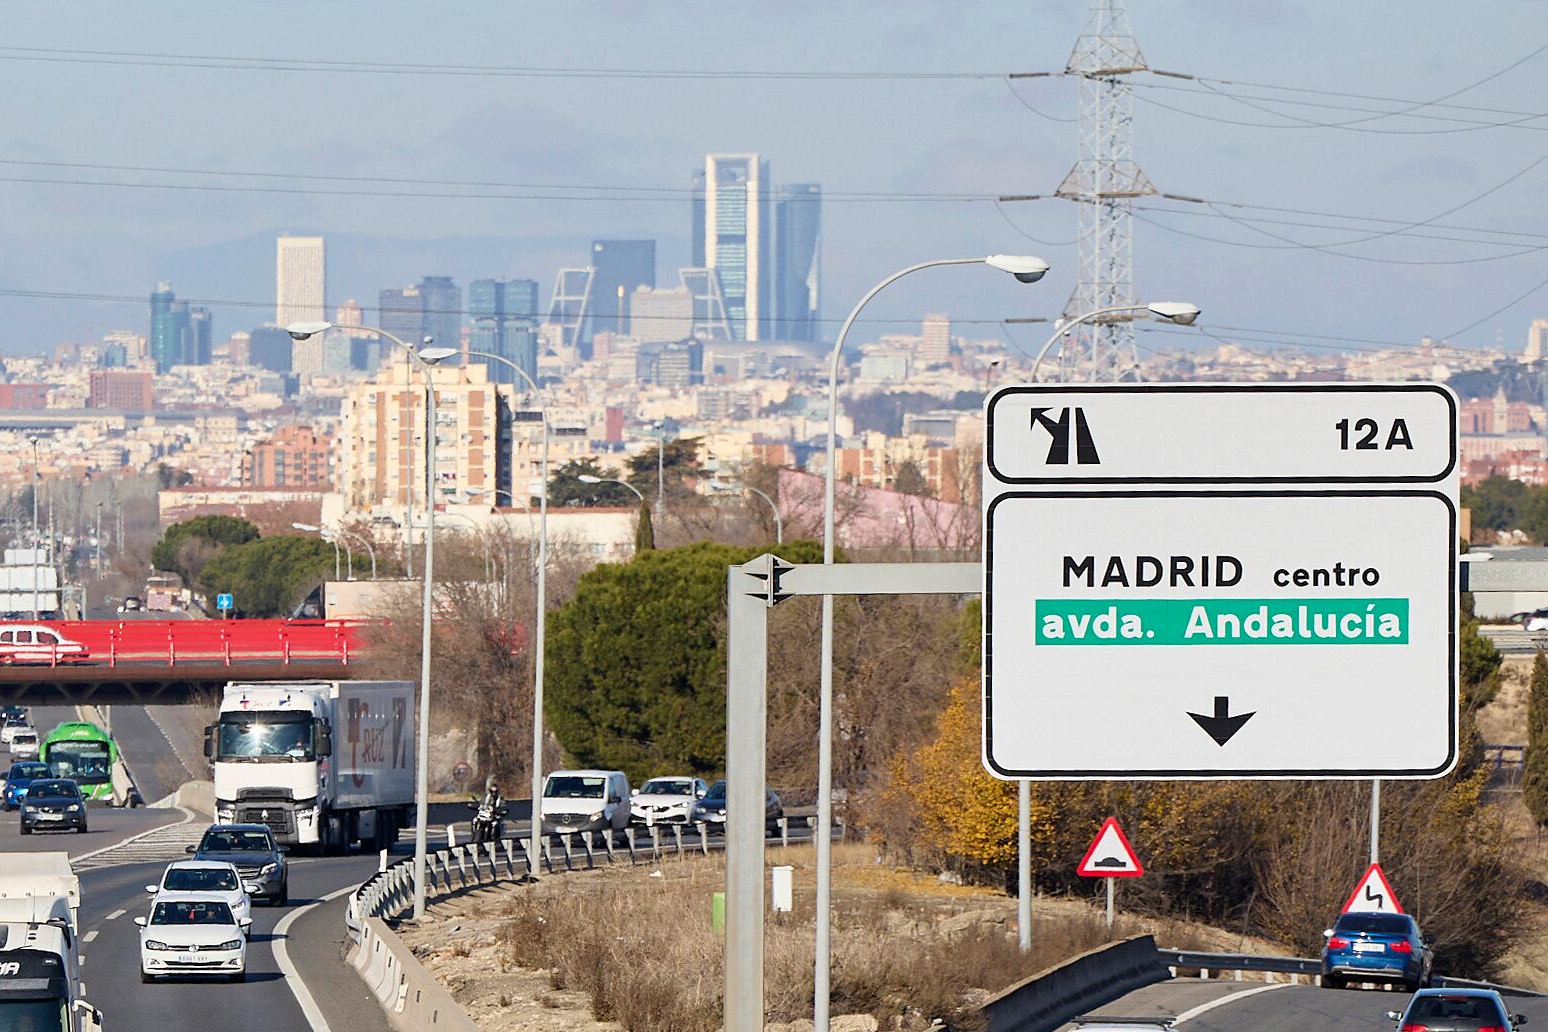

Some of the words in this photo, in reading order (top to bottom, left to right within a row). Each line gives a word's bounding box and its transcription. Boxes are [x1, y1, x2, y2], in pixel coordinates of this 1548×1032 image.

[1335, 418, 1414, 450] 12A
[1062, 555, 1243, 588] MADRID
[1273, 562, 1380, 588] centro
[1042, 606, 1155, 640] avda.
[1184, 604, 1401, 640] Andalucía
